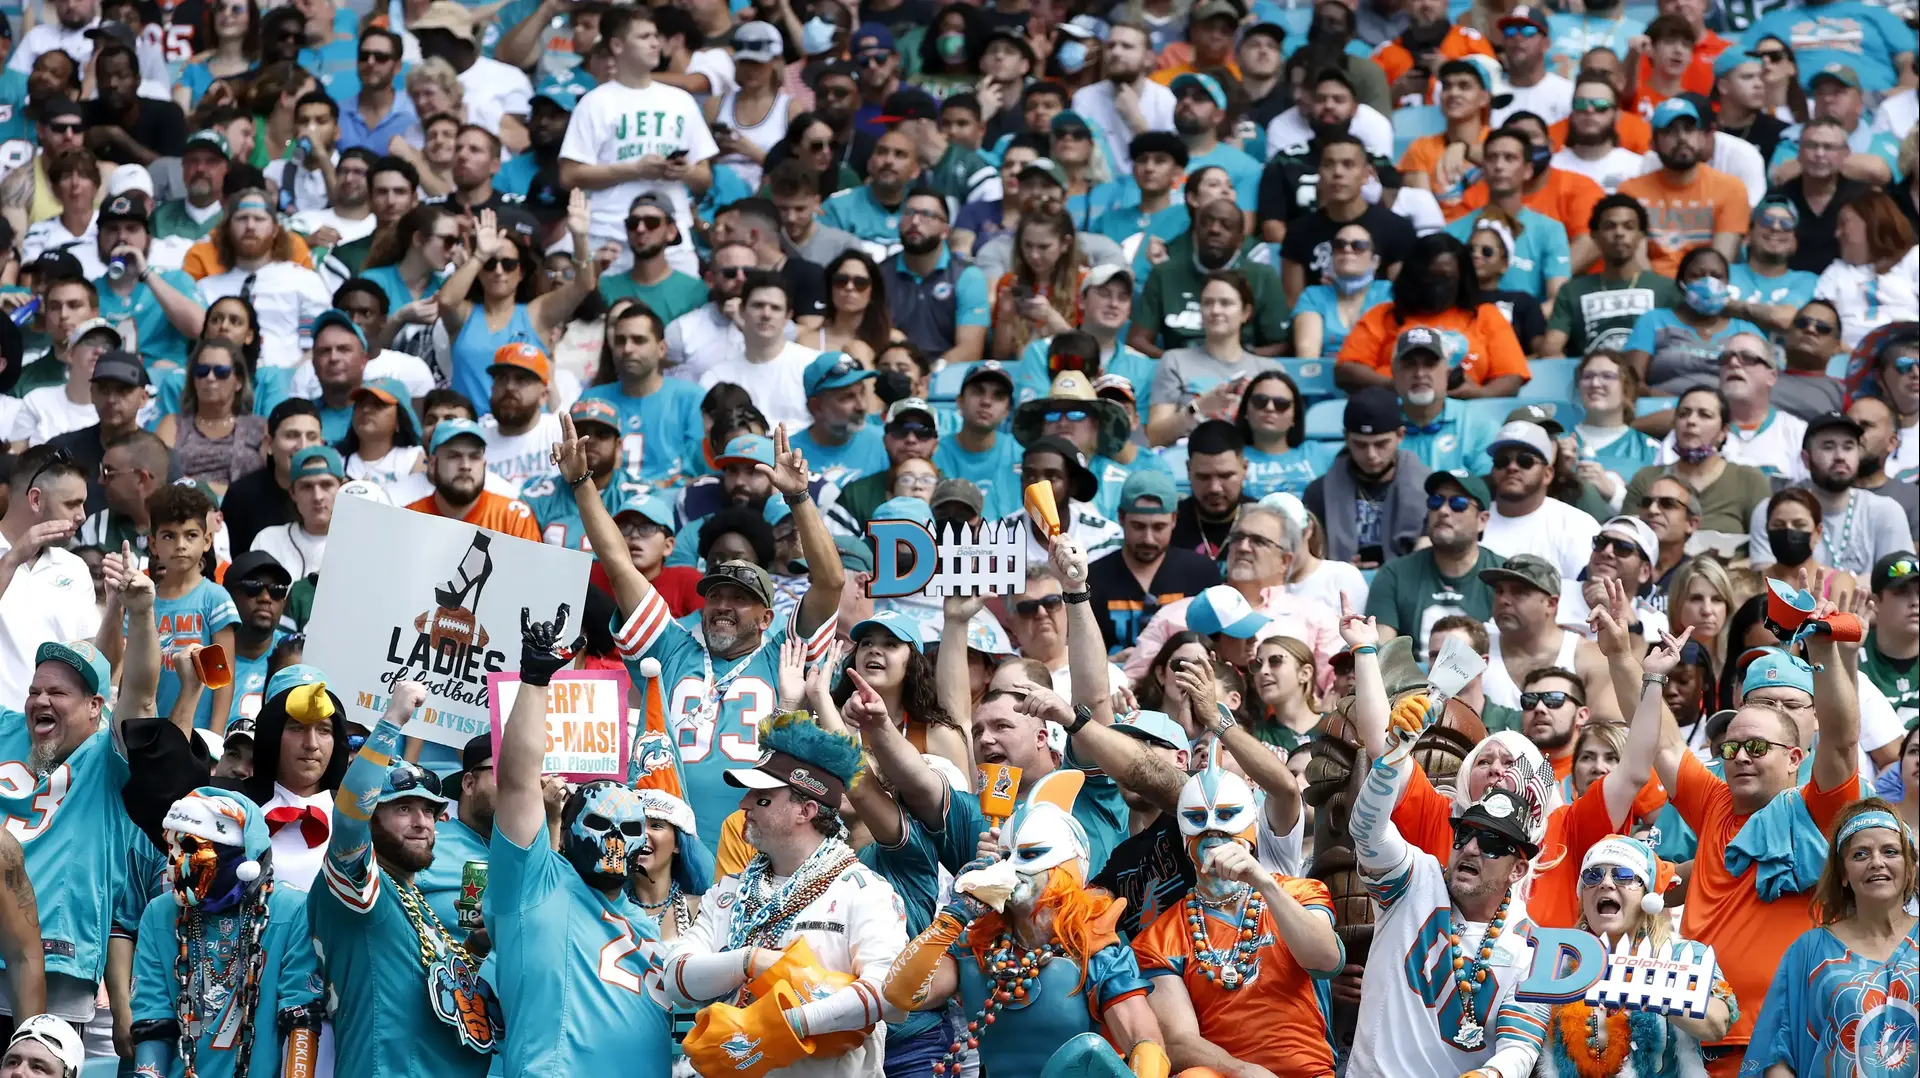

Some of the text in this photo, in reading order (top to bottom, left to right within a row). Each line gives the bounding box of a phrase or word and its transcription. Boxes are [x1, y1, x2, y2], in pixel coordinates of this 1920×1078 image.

[865, 519, 938, 598] D
[154, 615, 203, 633] AMI
[386, 626, 505, 685] LADIES
[356, 690, 491, 736] MIAI DIVISI
[670, 676, 775, 764] 83
[568, 755, 617, 773] Playoffs
[1514, 927, 1609, 1003] D
[1614, 956, 1690, 972] Dolphins
[294, 1029, 310, 1078] TACKLEC
